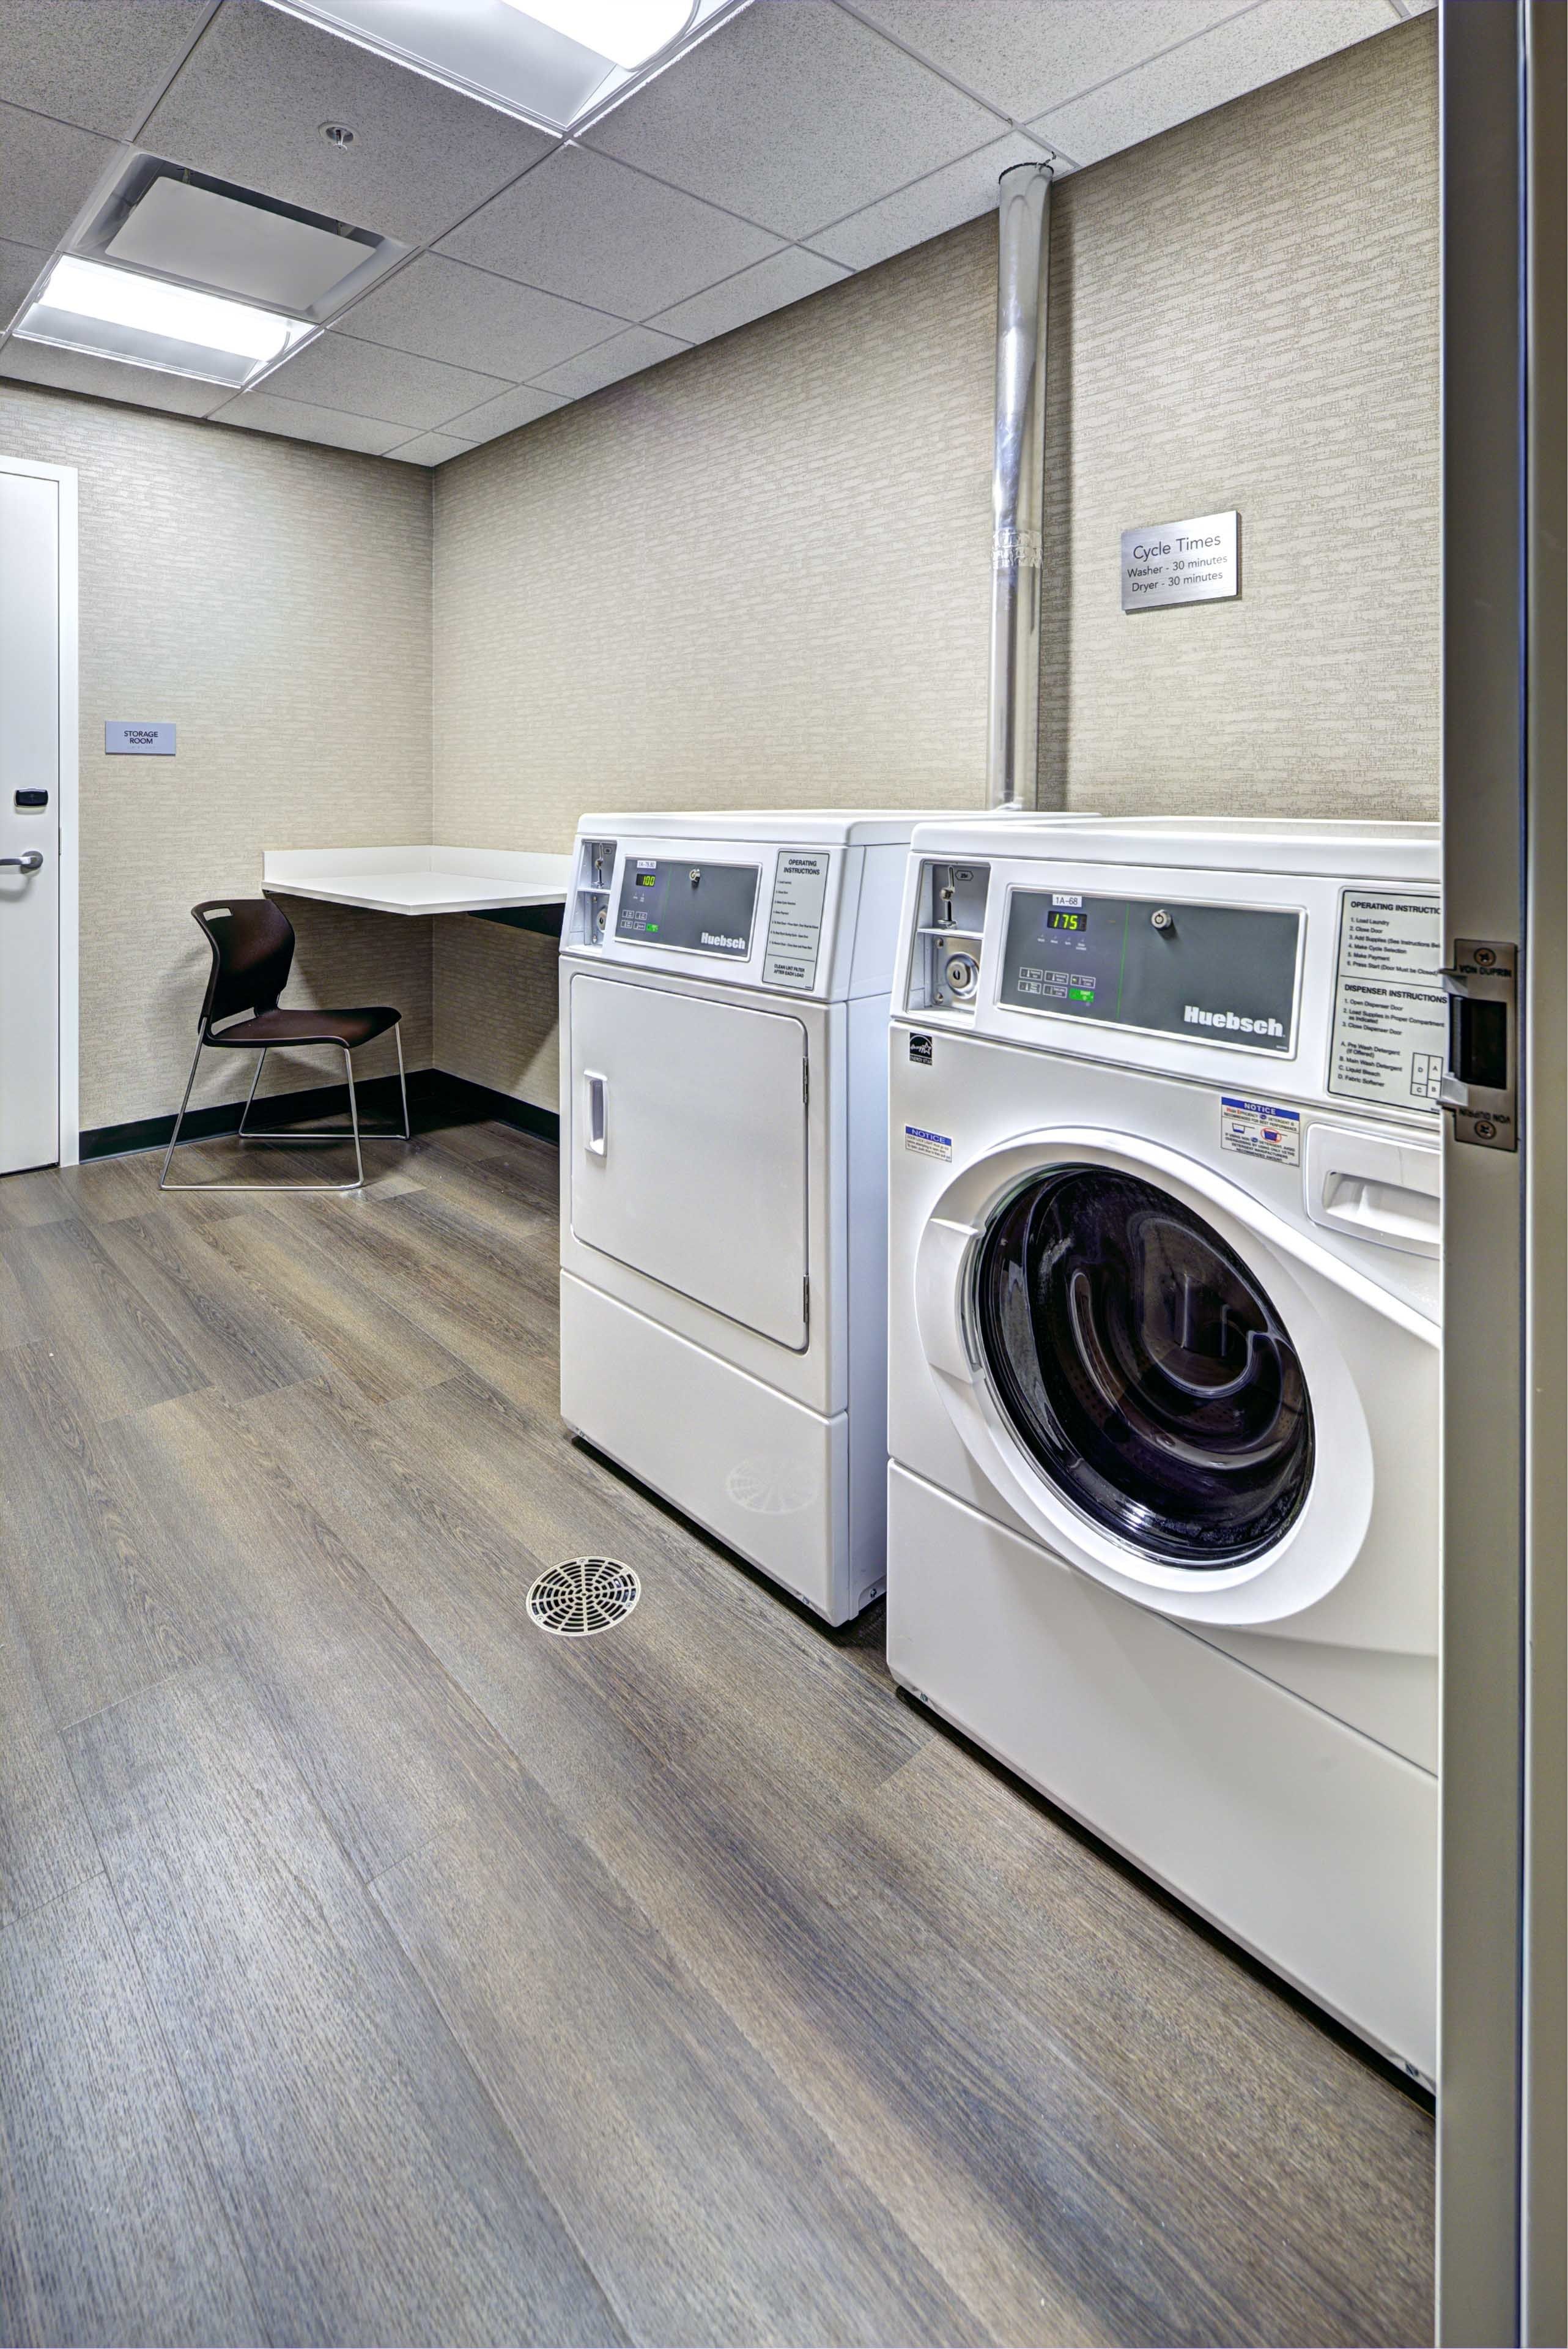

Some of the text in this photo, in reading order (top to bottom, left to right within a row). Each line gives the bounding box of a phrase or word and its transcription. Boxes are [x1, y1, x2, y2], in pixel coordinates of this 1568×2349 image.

[1133, 535, 1221, 562] Cycle Times
[1127, 566, 1163, 578] Washer
[1173, 561, 1185, 571] 30
[1188, 555, 1227, 568] minutes
[1132, 582, 1158, 593] Dryer
[1168, 576, 1180, 587] 30
[1183, 572, 1223, 584] minutes
[783, 867, 821, 875] INSTRUCTIONS
[643, 875, 656, 886] 100
[1056, 897, 1078, 905] 1A-68
[1351, 901, 1394, 911] OPERATING
[1054, 914, 1078, 930] 175
[701, 932, 746, 950] Huebsch
[1459, 964, 1477, 974] VON
[1345, 984, 1448, 1004] DISPENSER INSTRUCTIONS
[1364, 1001, 1389, 1009] Dispenser
[1184, 1005, 1284, 1037] Huebsch
[1363, 1011, 1384, 1019] Supplies
[1409, 1017, 1444, 1028] Compartment
[1363, 1024, 1388, 1033] Dispenser
[1353, 1050, 1375, 1058] Offered)
[1374, 1046, 1400, 1056] Detergent
[1376, 1062, 1402, 1072] Detergent
[1362, 1078, 1385, 1087] Softener
[1244, 1102, 1276, 1115] NOTICE
[911, 1129, 945, 1144] NOTICE
